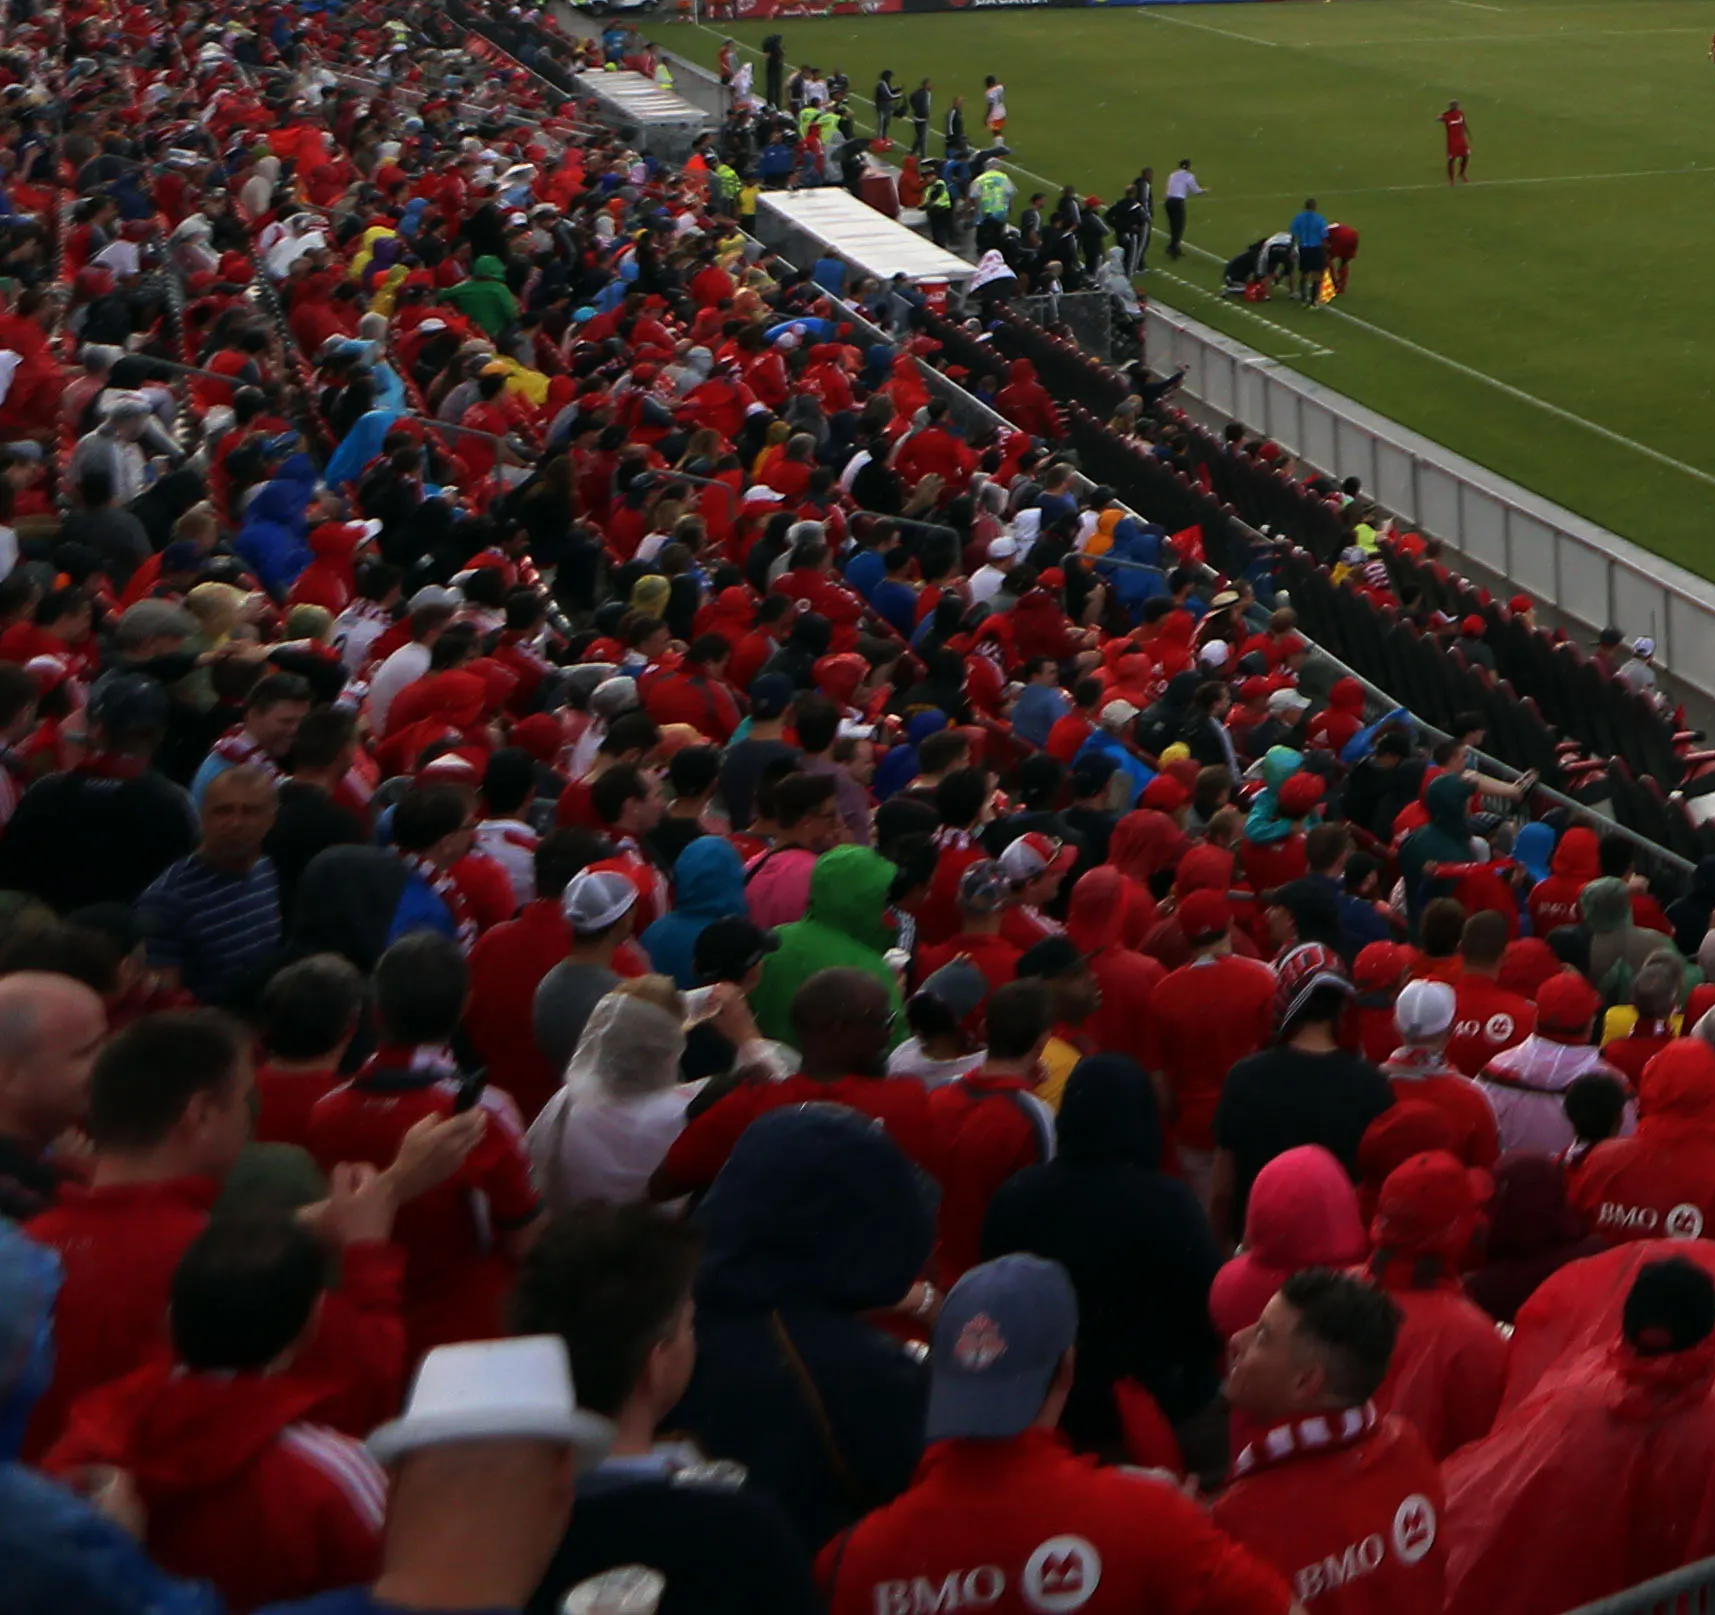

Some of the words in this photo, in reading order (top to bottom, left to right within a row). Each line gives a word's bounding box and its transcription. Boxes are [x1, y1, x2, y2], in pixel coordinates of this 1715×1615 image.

[1600, 1201, 1658, 1230] BMO
[878, 1564, 1007, 1615] BMO
[1294, 1532, 1386, 1600] BMO
